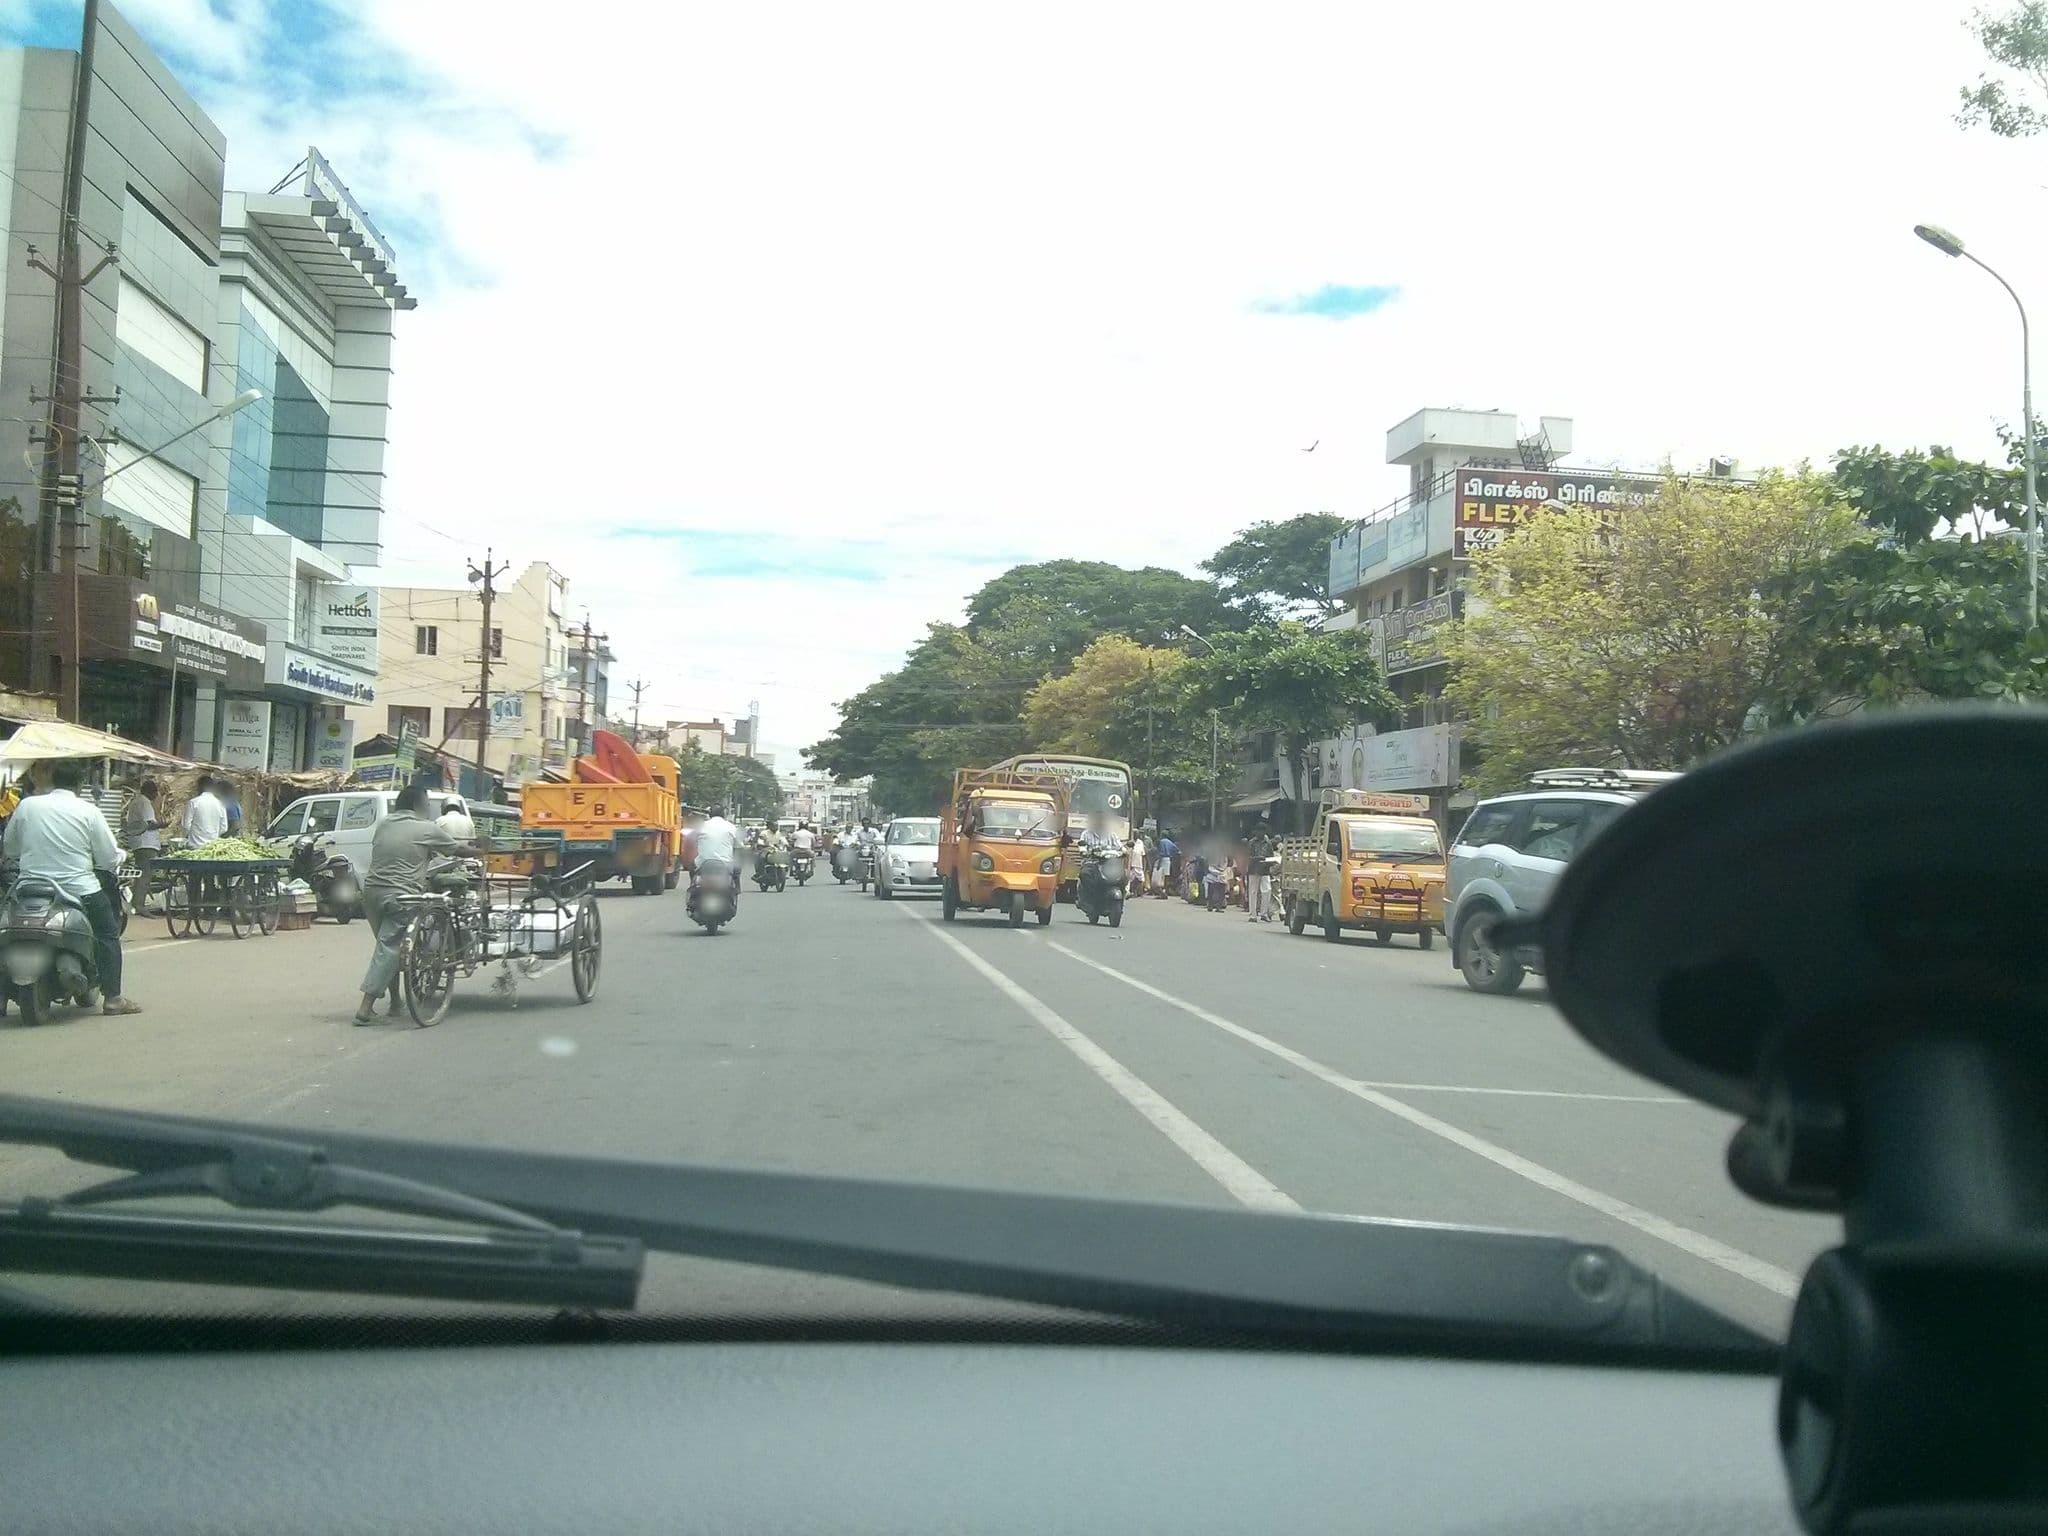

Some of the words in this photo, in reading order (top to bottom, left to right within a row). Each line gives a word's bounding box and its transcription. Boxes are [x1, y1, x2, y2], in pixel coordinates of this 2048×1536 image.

[1464, 478, 1548, 499] பிளக்ஸ்
[1463, 502, 1529, 523] FLEX
[328, 604, 371, 617] Hettich
[226, 745, 260, 754] TATTVA
[573, 792, 584, 805] E
[594, 803, 605, 816] B
